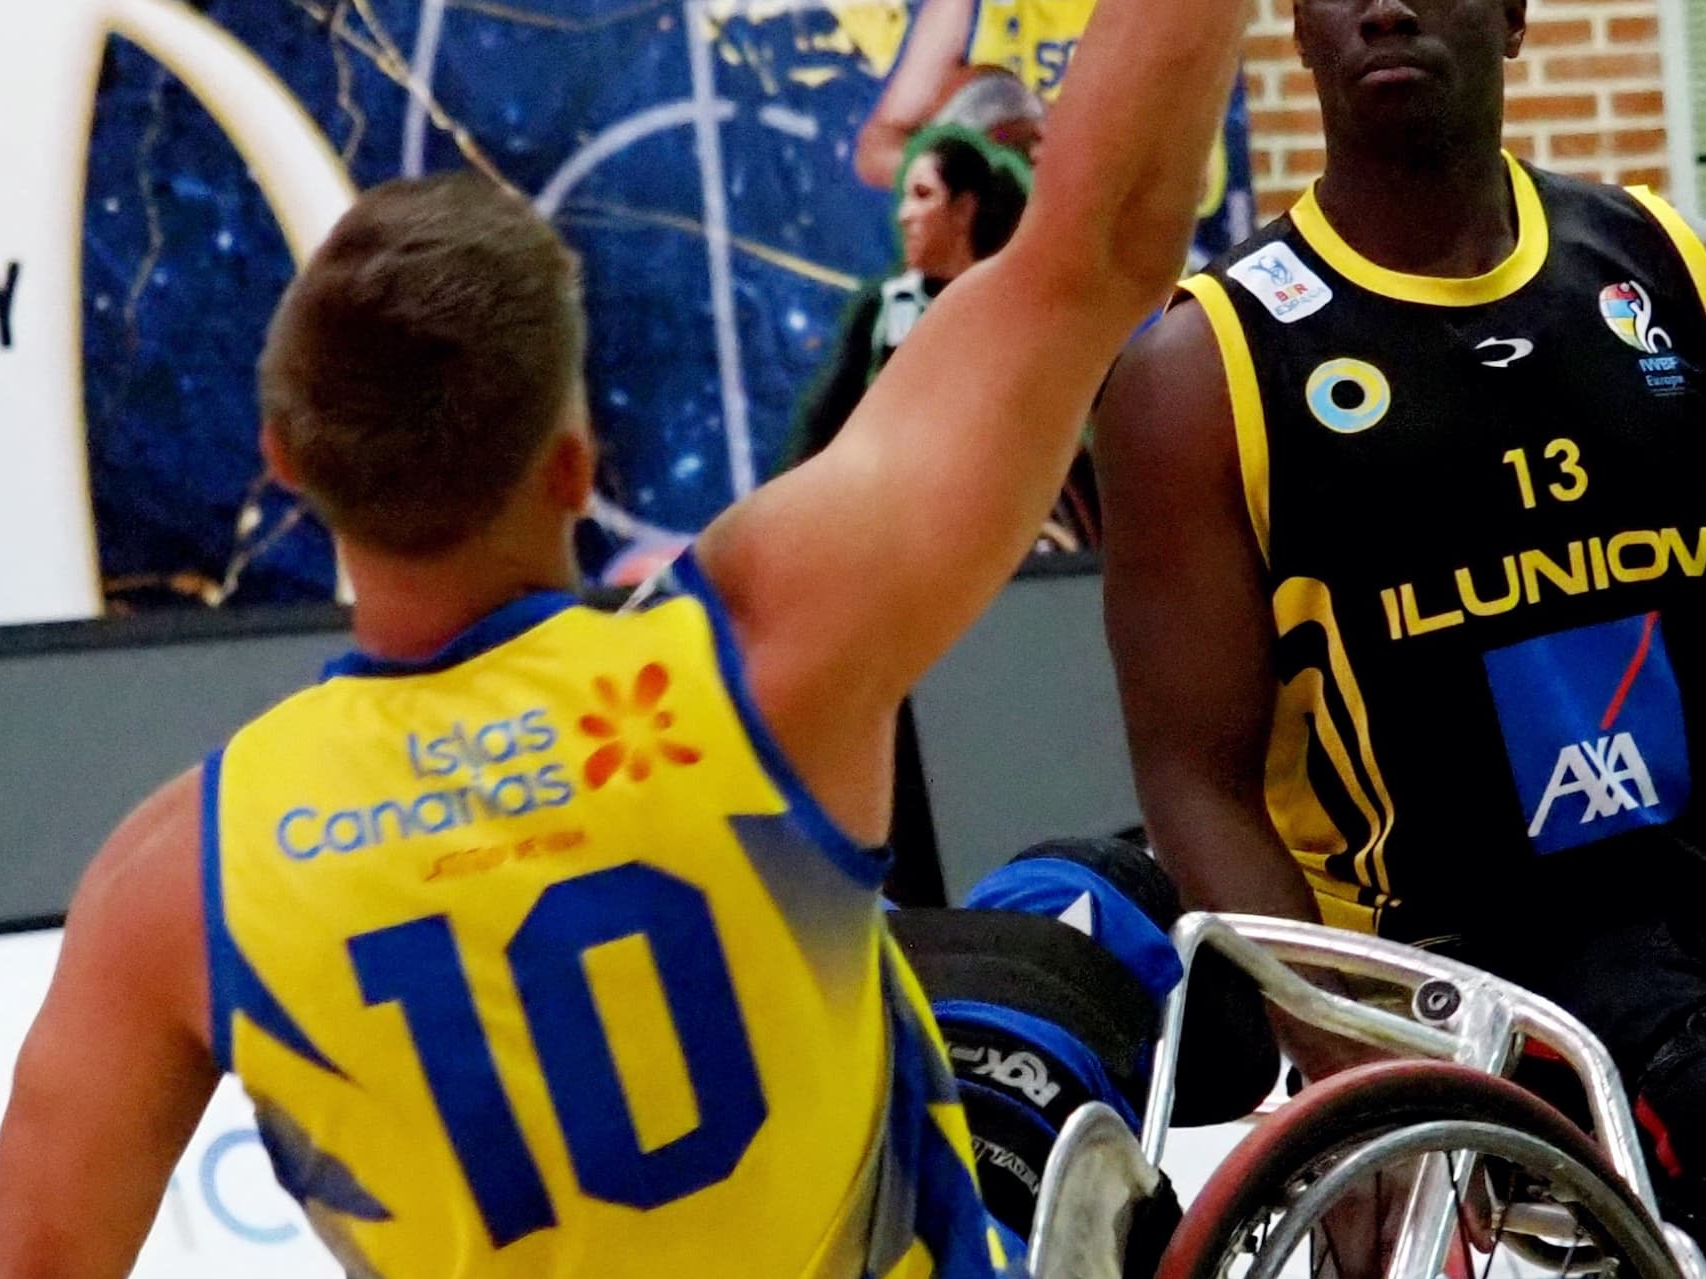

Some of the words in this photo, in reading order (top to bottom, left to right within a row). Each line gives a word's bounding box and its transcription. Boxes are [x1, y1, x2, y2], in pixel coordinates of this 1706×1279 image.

[1502, 437, 1589, 510] 13
[407, 708, 559, 780] Islas
[1526, 731, 1659, 839] AXA
[345, 860, 770, 1250] 10
